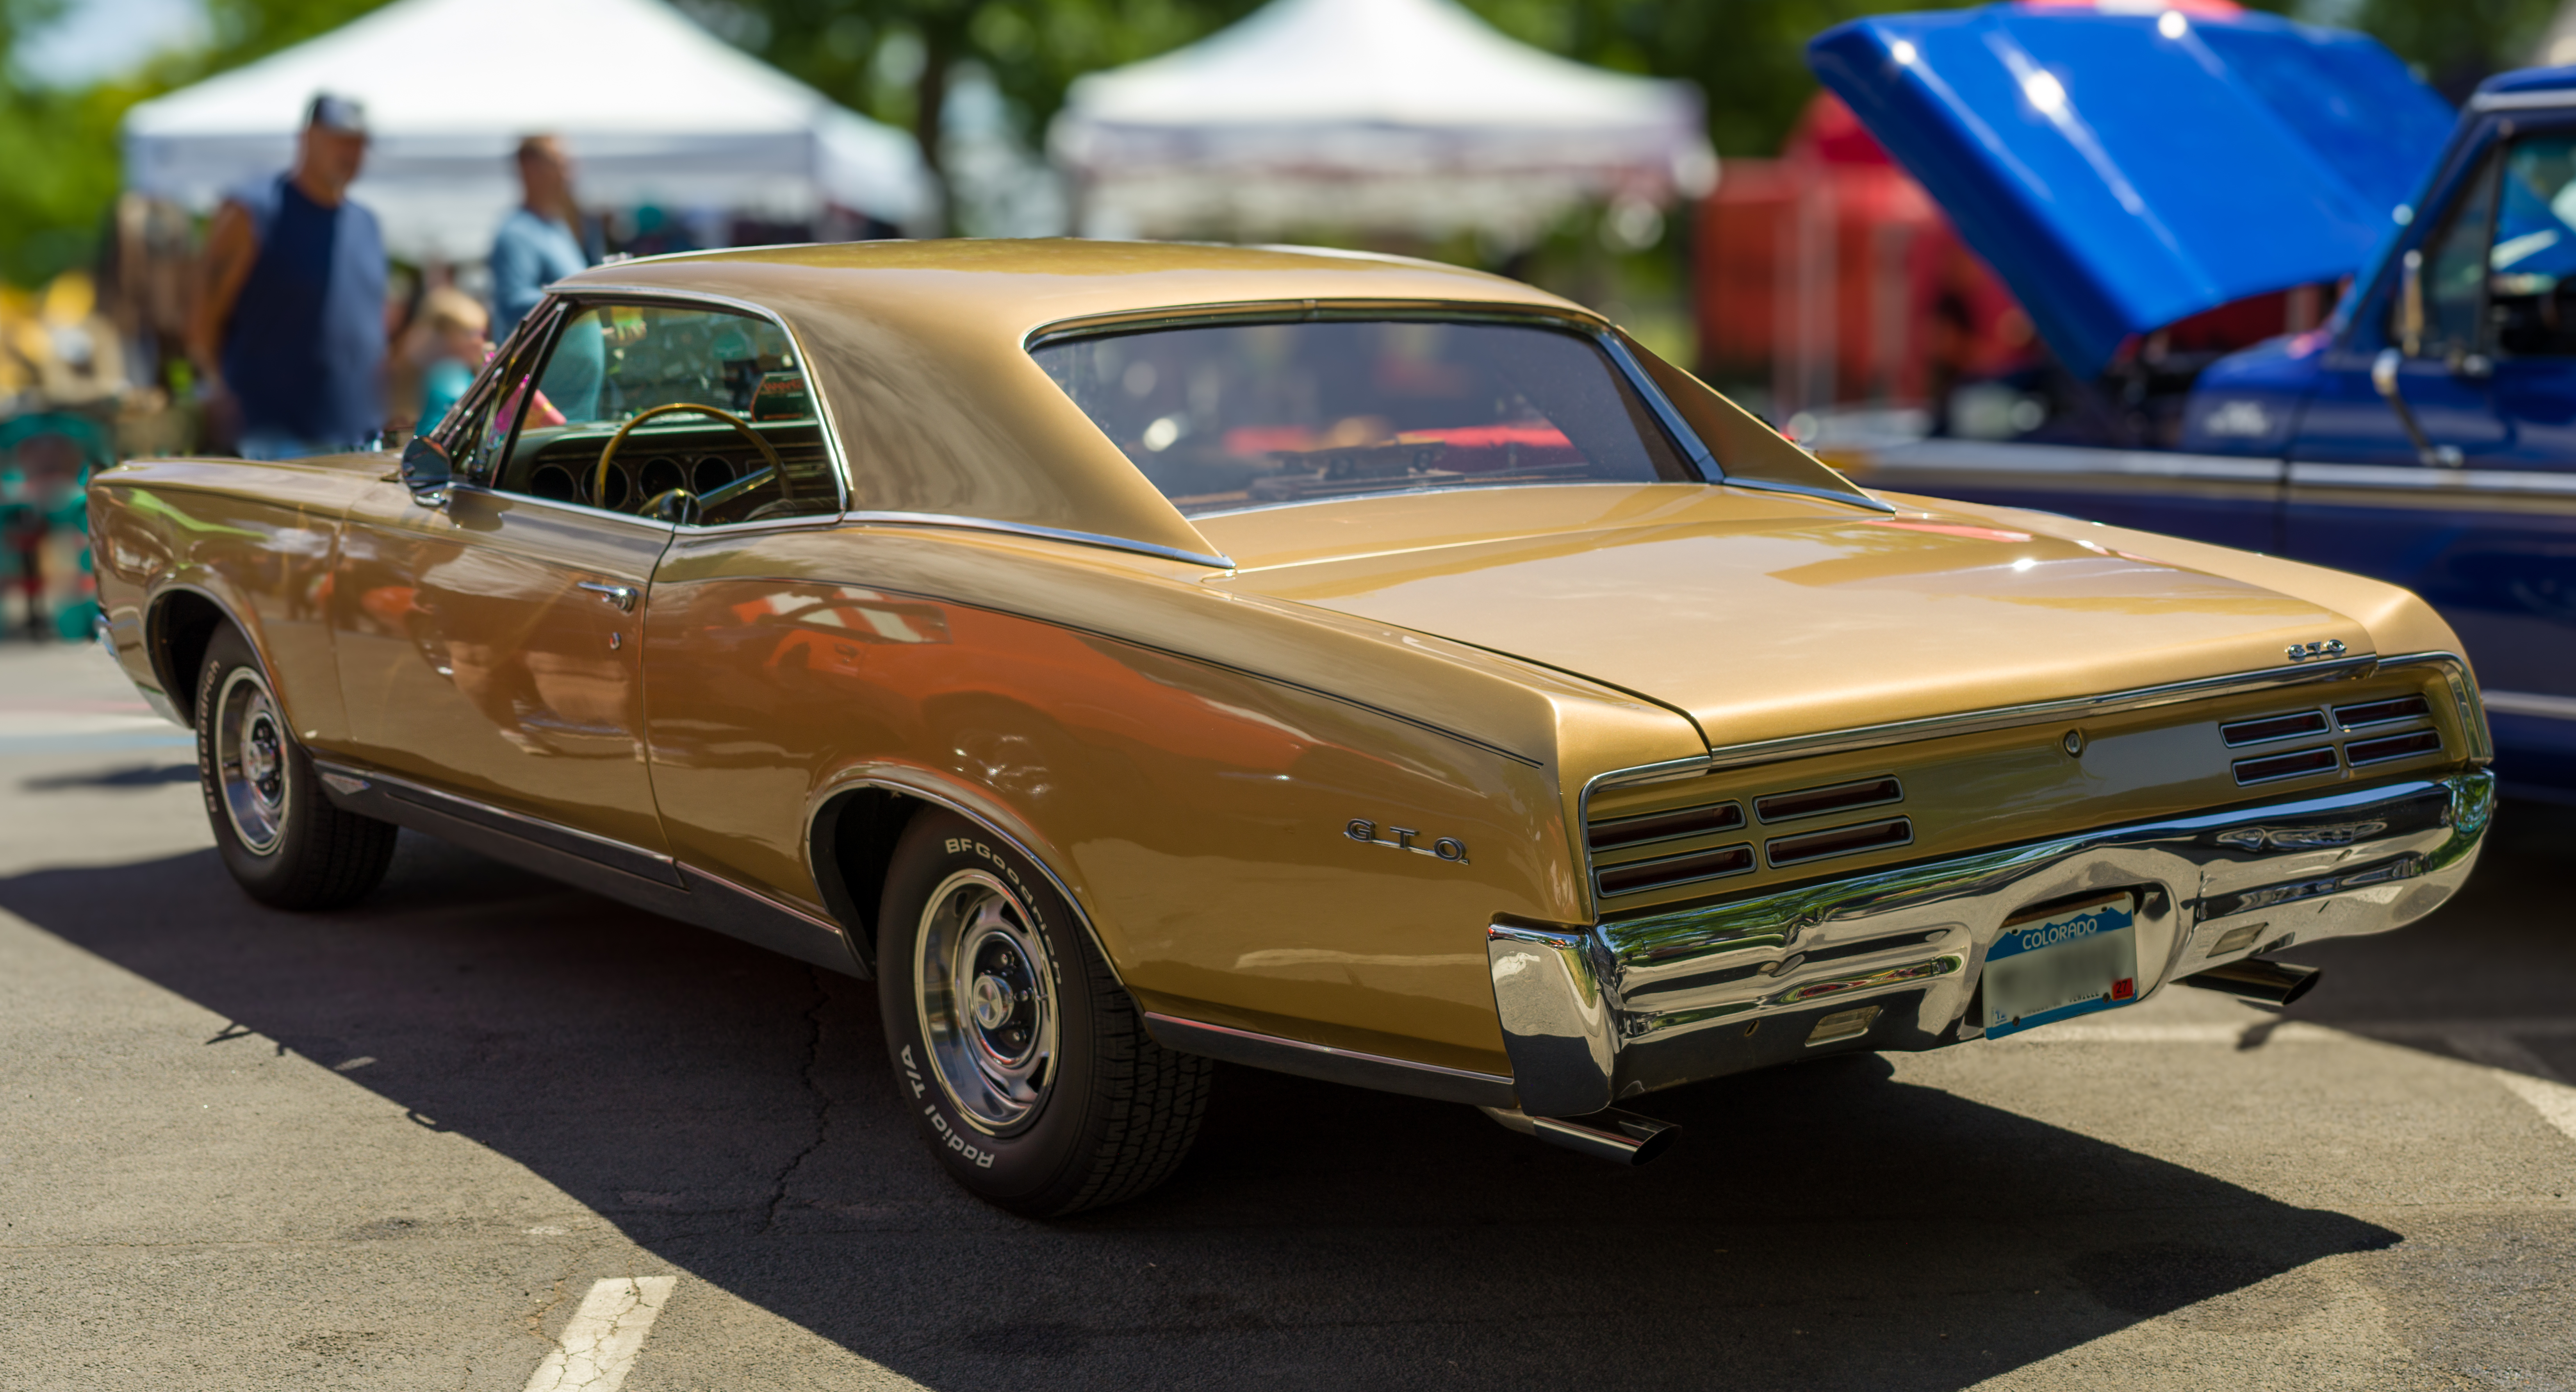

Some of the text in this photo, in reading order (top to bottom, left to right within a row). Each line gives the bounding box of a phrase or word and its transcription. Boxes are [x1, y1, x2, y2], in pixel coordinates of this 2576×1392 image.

[2286, 639, 2346, 657] GTO
[1344, 818, 1469, 864] GTO
[945, 838, 1062, 984] BFGoodrich
[2022, 918, 2097, 950] COLORADO
[2115, 980, 2128, 994] 27
[900, 1044, 995, 1169] Radial T/A
